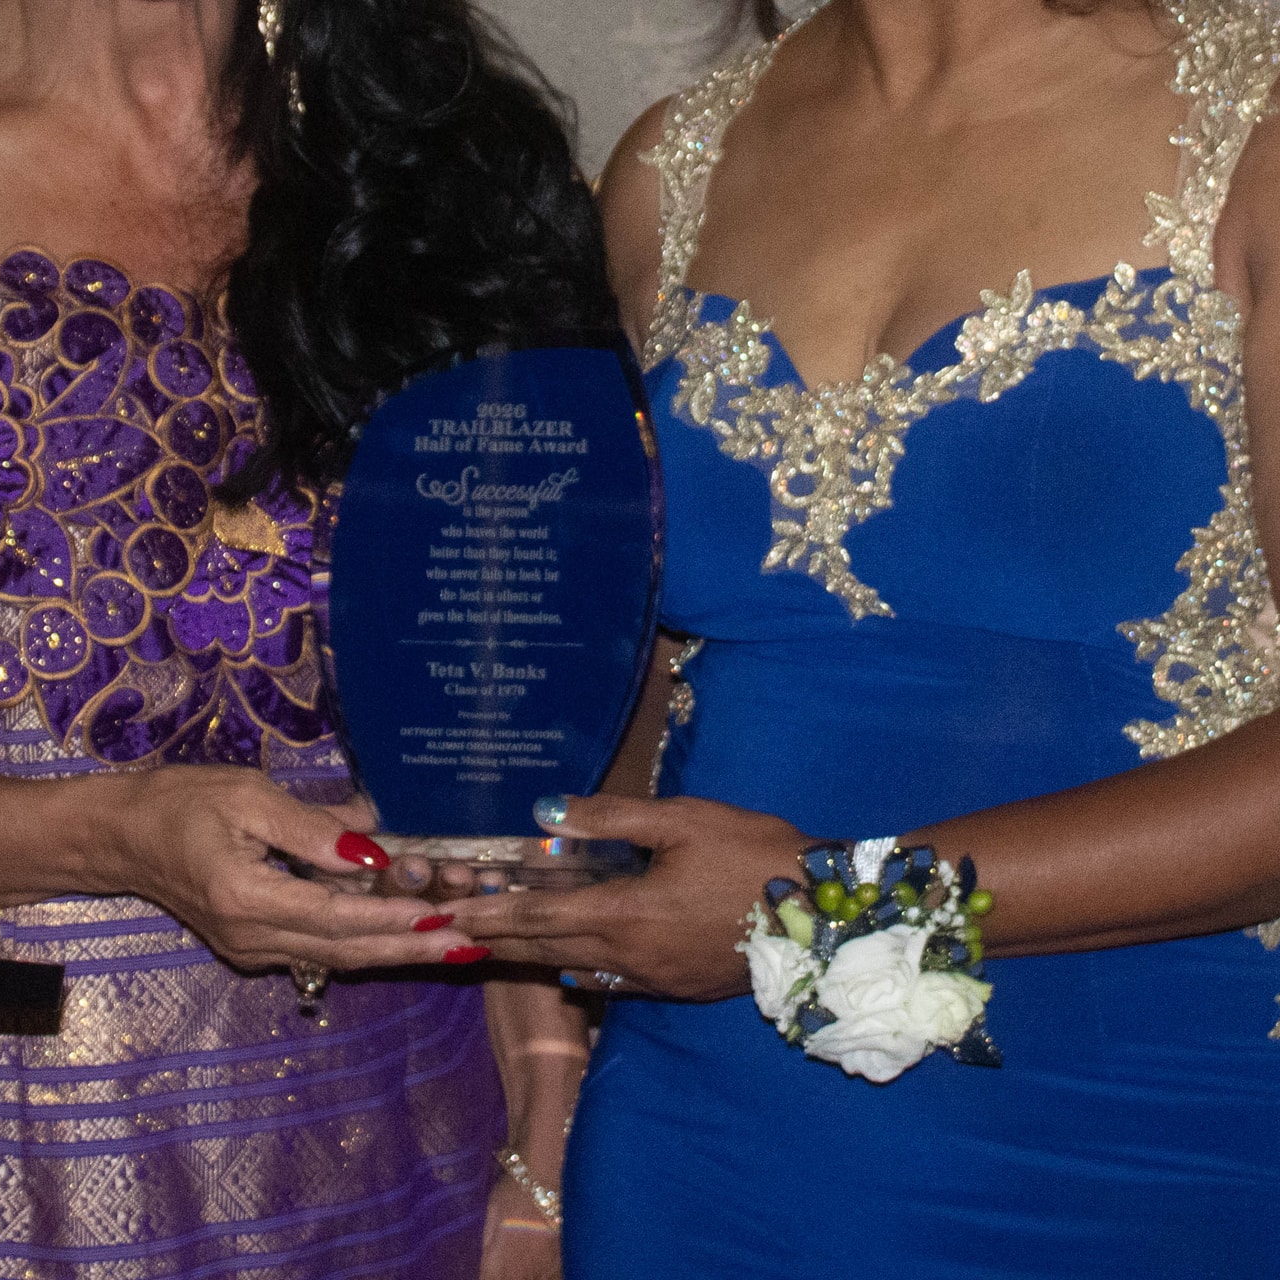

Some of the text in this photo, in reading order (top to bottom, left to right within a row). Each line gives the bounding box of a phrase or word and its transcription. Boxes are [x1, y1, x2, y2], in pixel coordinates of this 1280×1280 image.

[476, 403, 527, 419] 2026
[428, 419, 574, 437] TRAILBLAZER
[414, 435, 588, 454] Hall of Fame Award
[415, 465, 580, 511] Successful
[475, 504, 492, 518] the
[493, 507, 529, 521] person
[440, 524, 549, 539] who leaves the world
[429, 544, 461, 559] better
[463, 545, 486, 559] than
[488, 546, 511, 563] they
[513, 546, 543, 560] found
[425, 565, 560, 582] who never fails to look for
[439, 587, 543, 603] the best in others or
[417, 608, 445, 625] gives
[447, 608, 464, 623] the
[466, 609, 488, 624] best
[489, 609, 502, 624] of
[426, 661, 547, 680] Teta V. Banks
[443, 682, 527, 697] Class of 1970
[399, 726, 565, 740] DETROIT CENTRAL HIGH SCHOOL
[425, 741, 543, 753] ALUMNI ORGANIZATION
